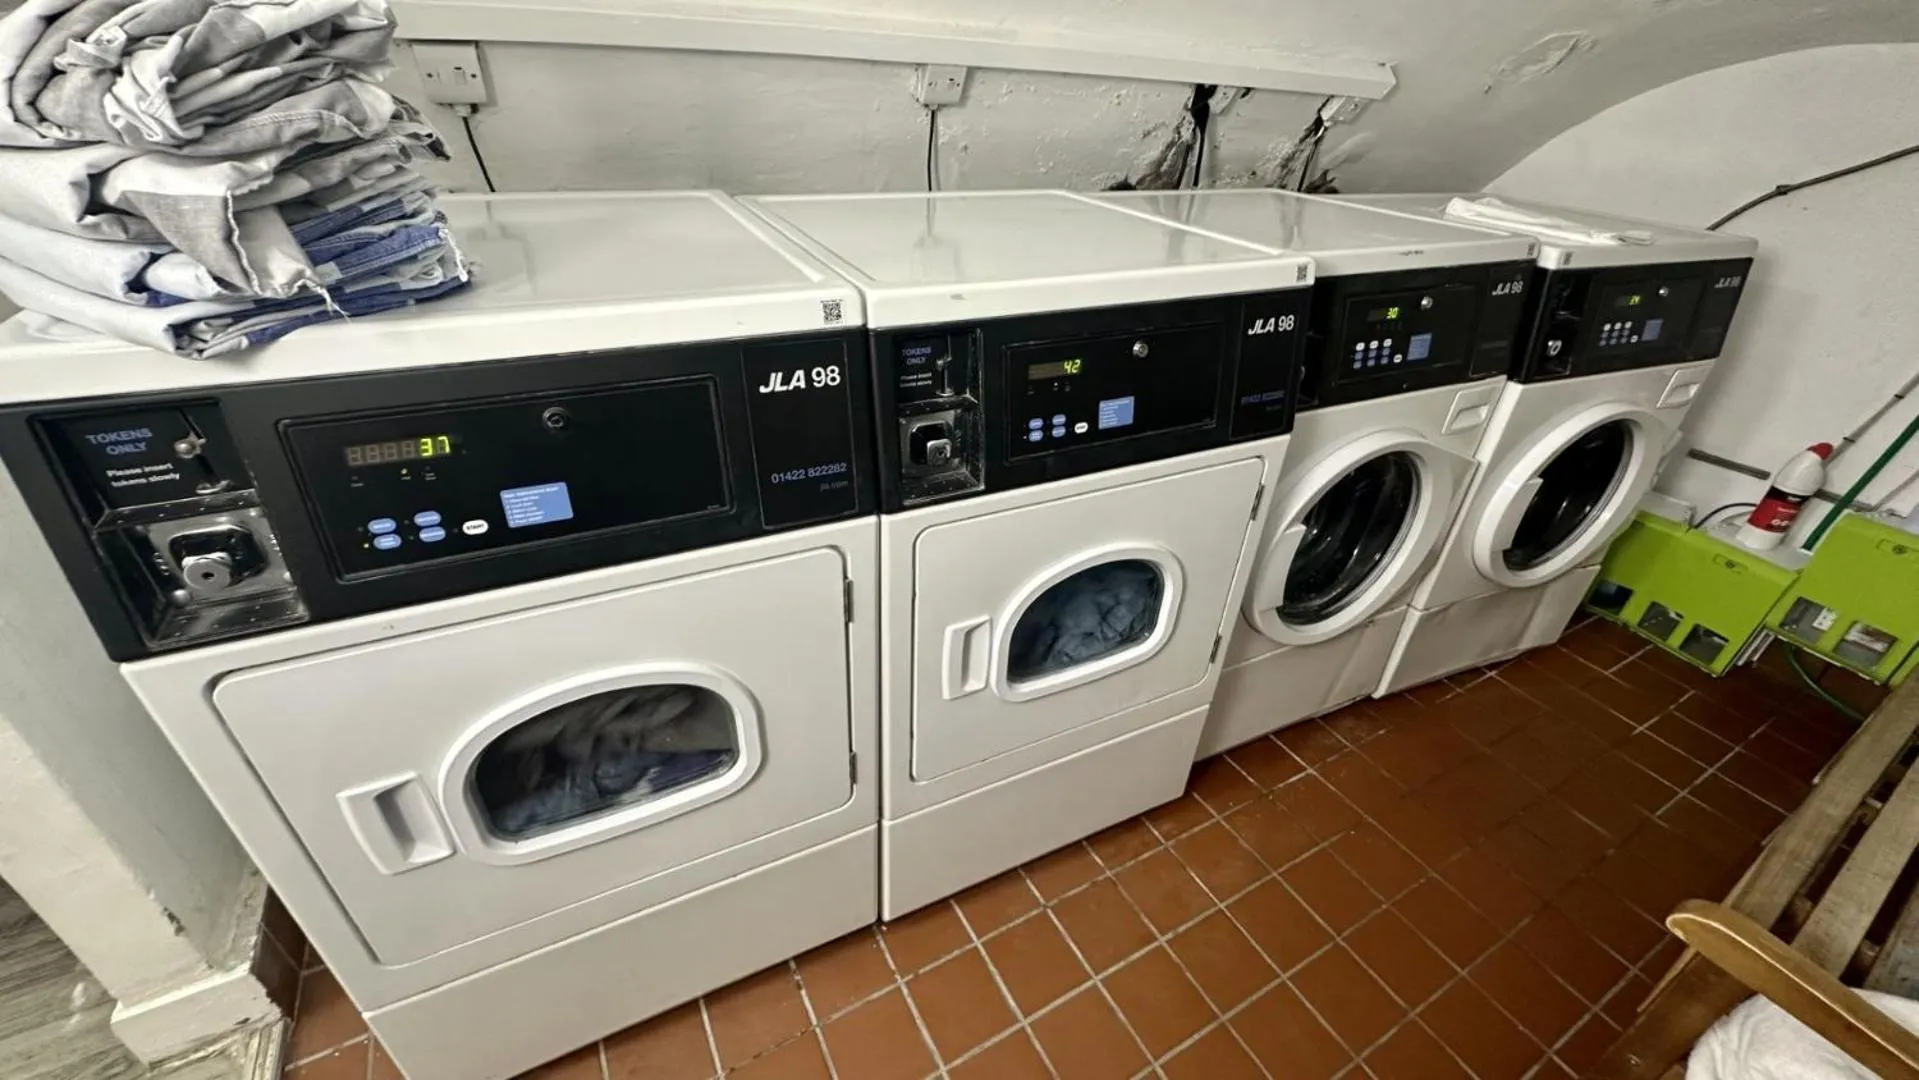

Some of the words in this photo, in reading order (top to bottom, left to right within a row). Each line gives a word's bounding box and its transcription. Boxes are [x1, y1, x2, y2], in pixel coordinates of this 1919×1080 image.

[1492, 281, 1511, 296] JLA
[1511, 280, 1524, 294] 98
[1247, 316, 1276, 335] JLA
[1278, 314, 1295, 332] 98
[901, 346, 932, 356] TOKENS
[1063, 359, 1081, 374] 42
[759, 369, 806, 394] JLA
[811, 365, 841, 388] 98
[85, 428, 153, 444] TOKENS
[106, 441, 147, 455] ONLY
[420, 435, 451, 457] 37
[771, 468, 807, 484] 01422
[807, 462, 848, 477] 822282
